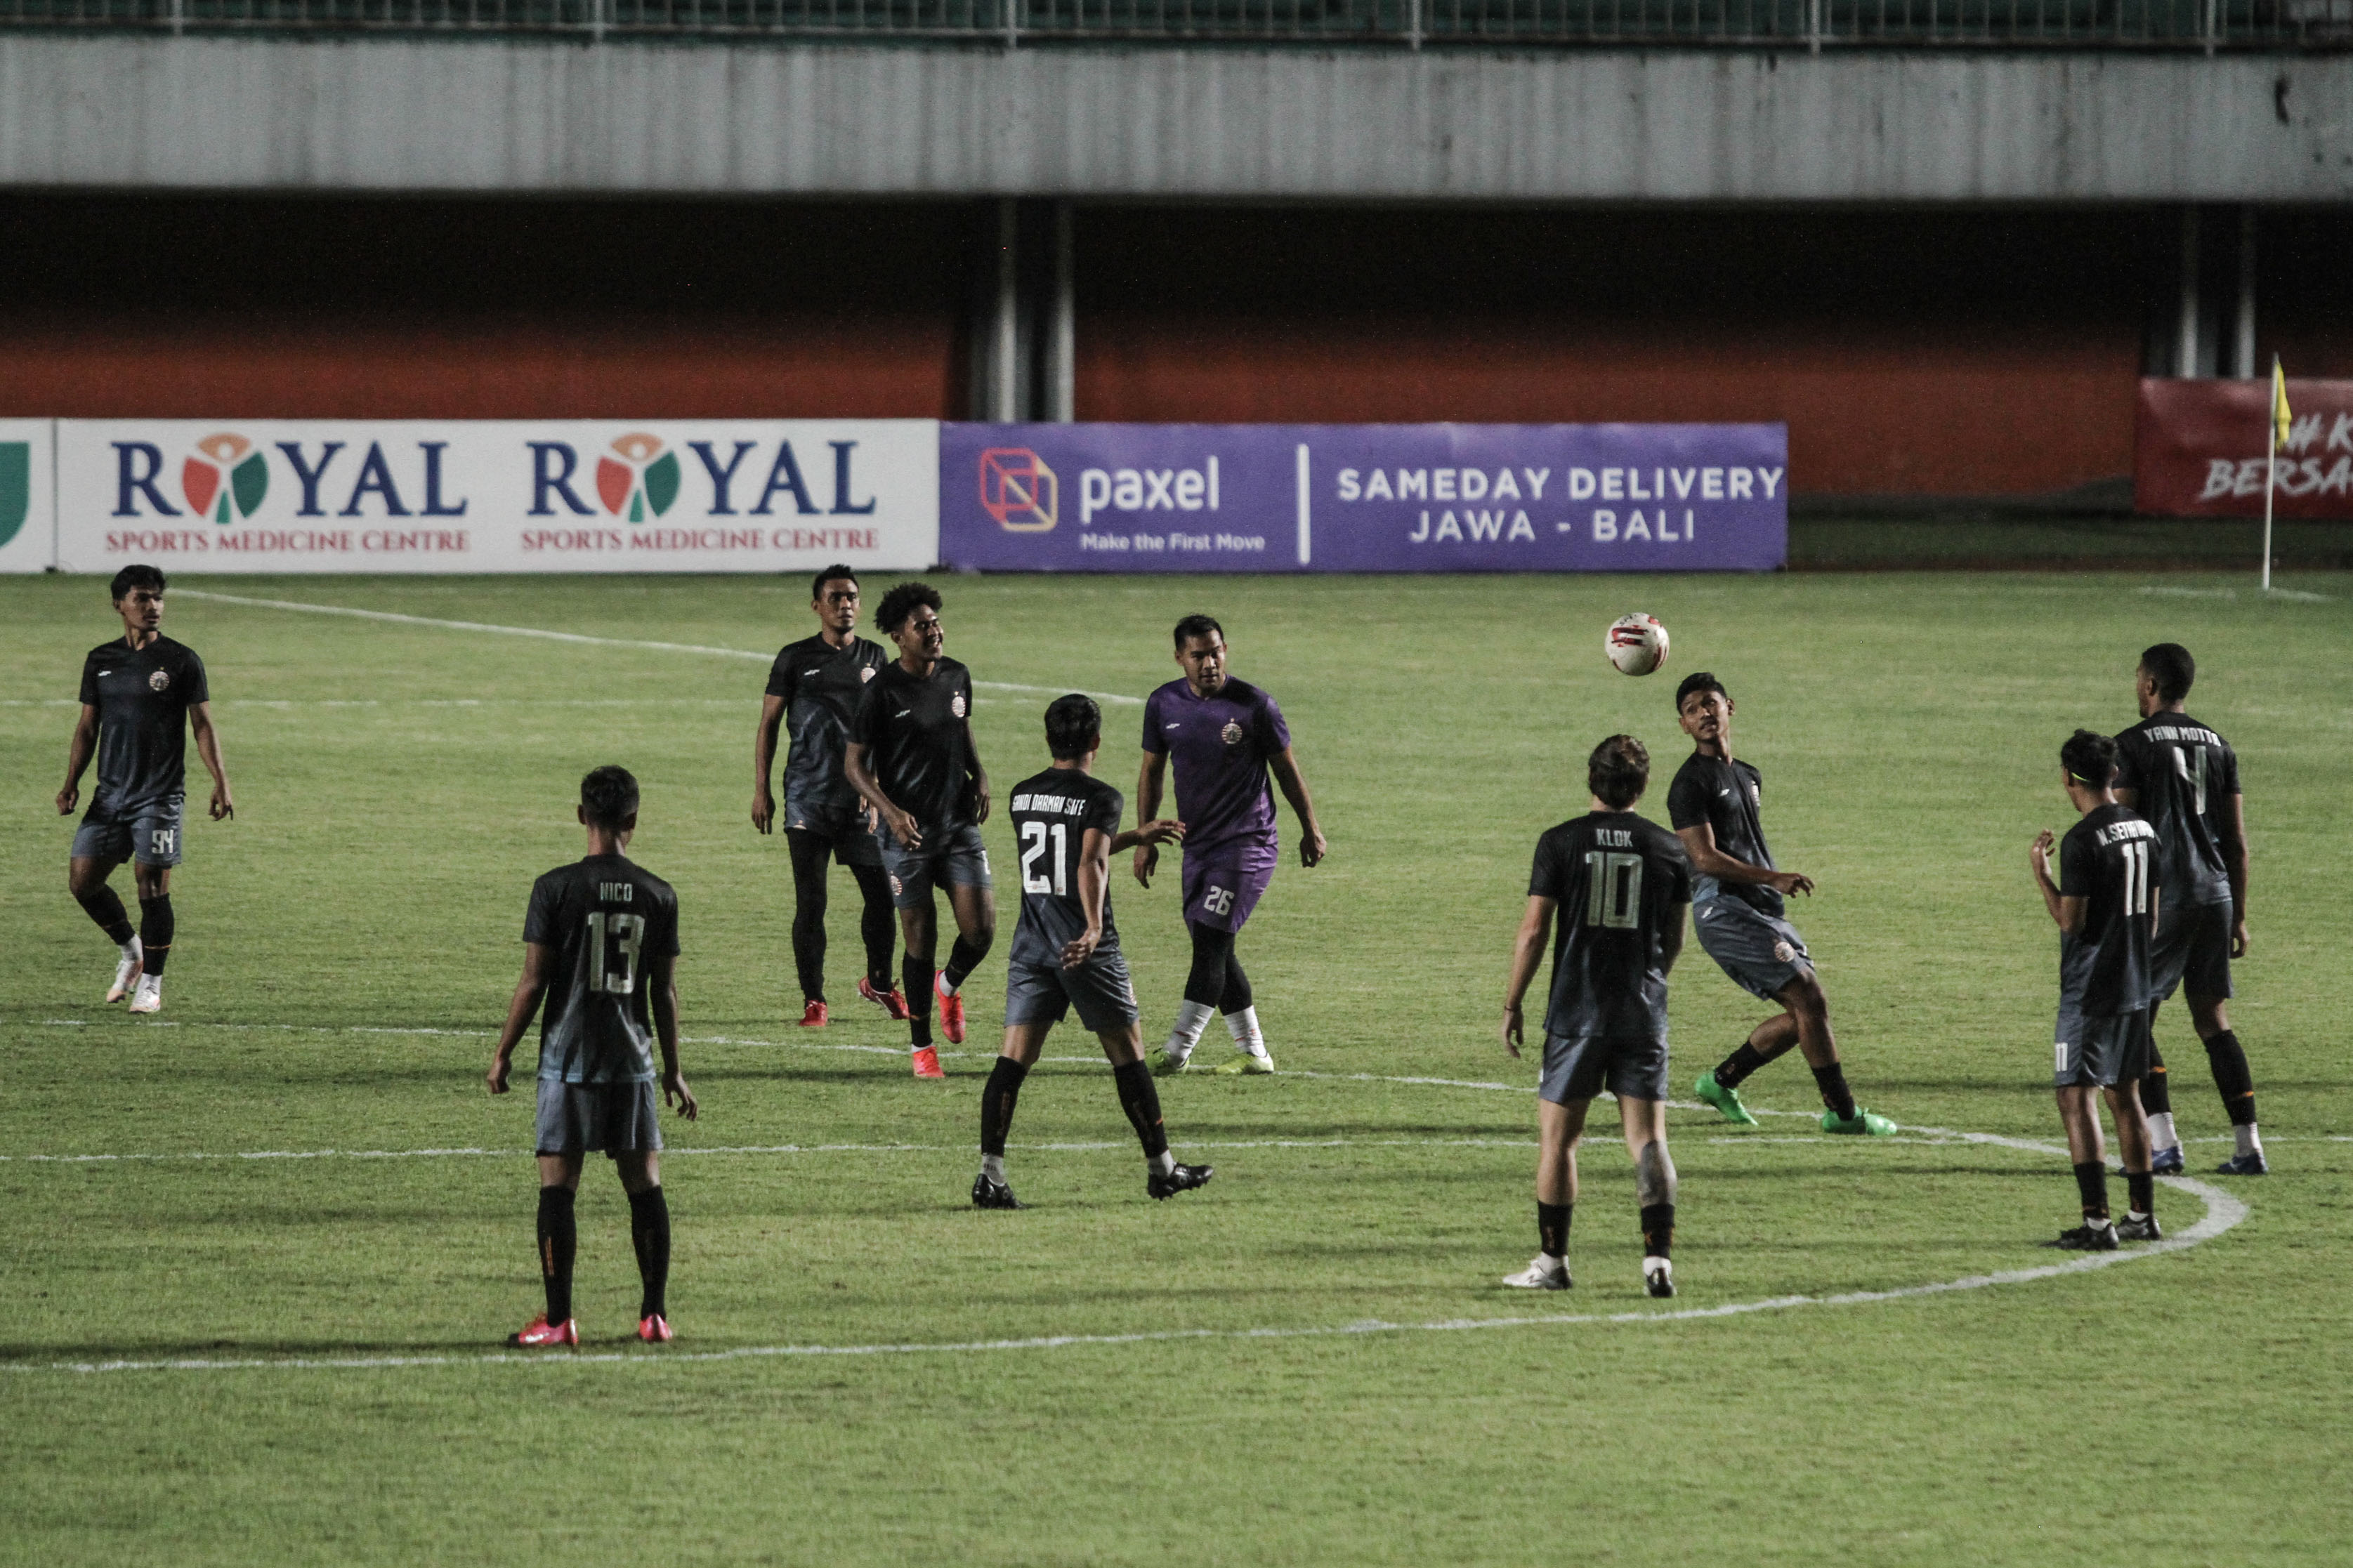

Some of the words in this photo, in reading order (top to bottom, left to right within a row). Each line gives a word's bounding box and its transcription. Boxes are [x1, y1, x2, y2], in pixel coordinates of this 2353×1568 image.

[110, 431, 468, 525] ROYAL
[525, 431, 877, 524] ROYAL
[1079, 454, 1220, 525] paxel
[1337, 467, 1551, 501] SAMEDAY
[1568, 467, 1785, 501] DELIVERY
[105, 530, 209, 552] SPORTS
[217, 530, 350, 552] MEDICINE
[361, 530, 471, 552] CENTRE
[521, 529, 623, 551] SPORTS
[631, 529, 765, 551] MEDICINE
[773, 529, 879, 551] CENTRE
[1080, 532, 1130, 551] Make
[1134, 532, 1166, 551] the
[1170, 532, 1211, 551] First
[1217, 533, 1266, 551] Move
[1409, 509, 1537, 542] JAWA
[1592, 508, 1695, 541] BALI
[2172, 744, 2207, 815] 4
[151, 829, 174, 854] 94
[1021, 820, 1067, 896] 21
[599, 881, 633, 902] NICO
[1203, 885, 1236, 916] 26
[1585, 850, 1644, 929] 10
[2121, 841, 2149, 916] 11
[588, 911, 646, 995] 13
